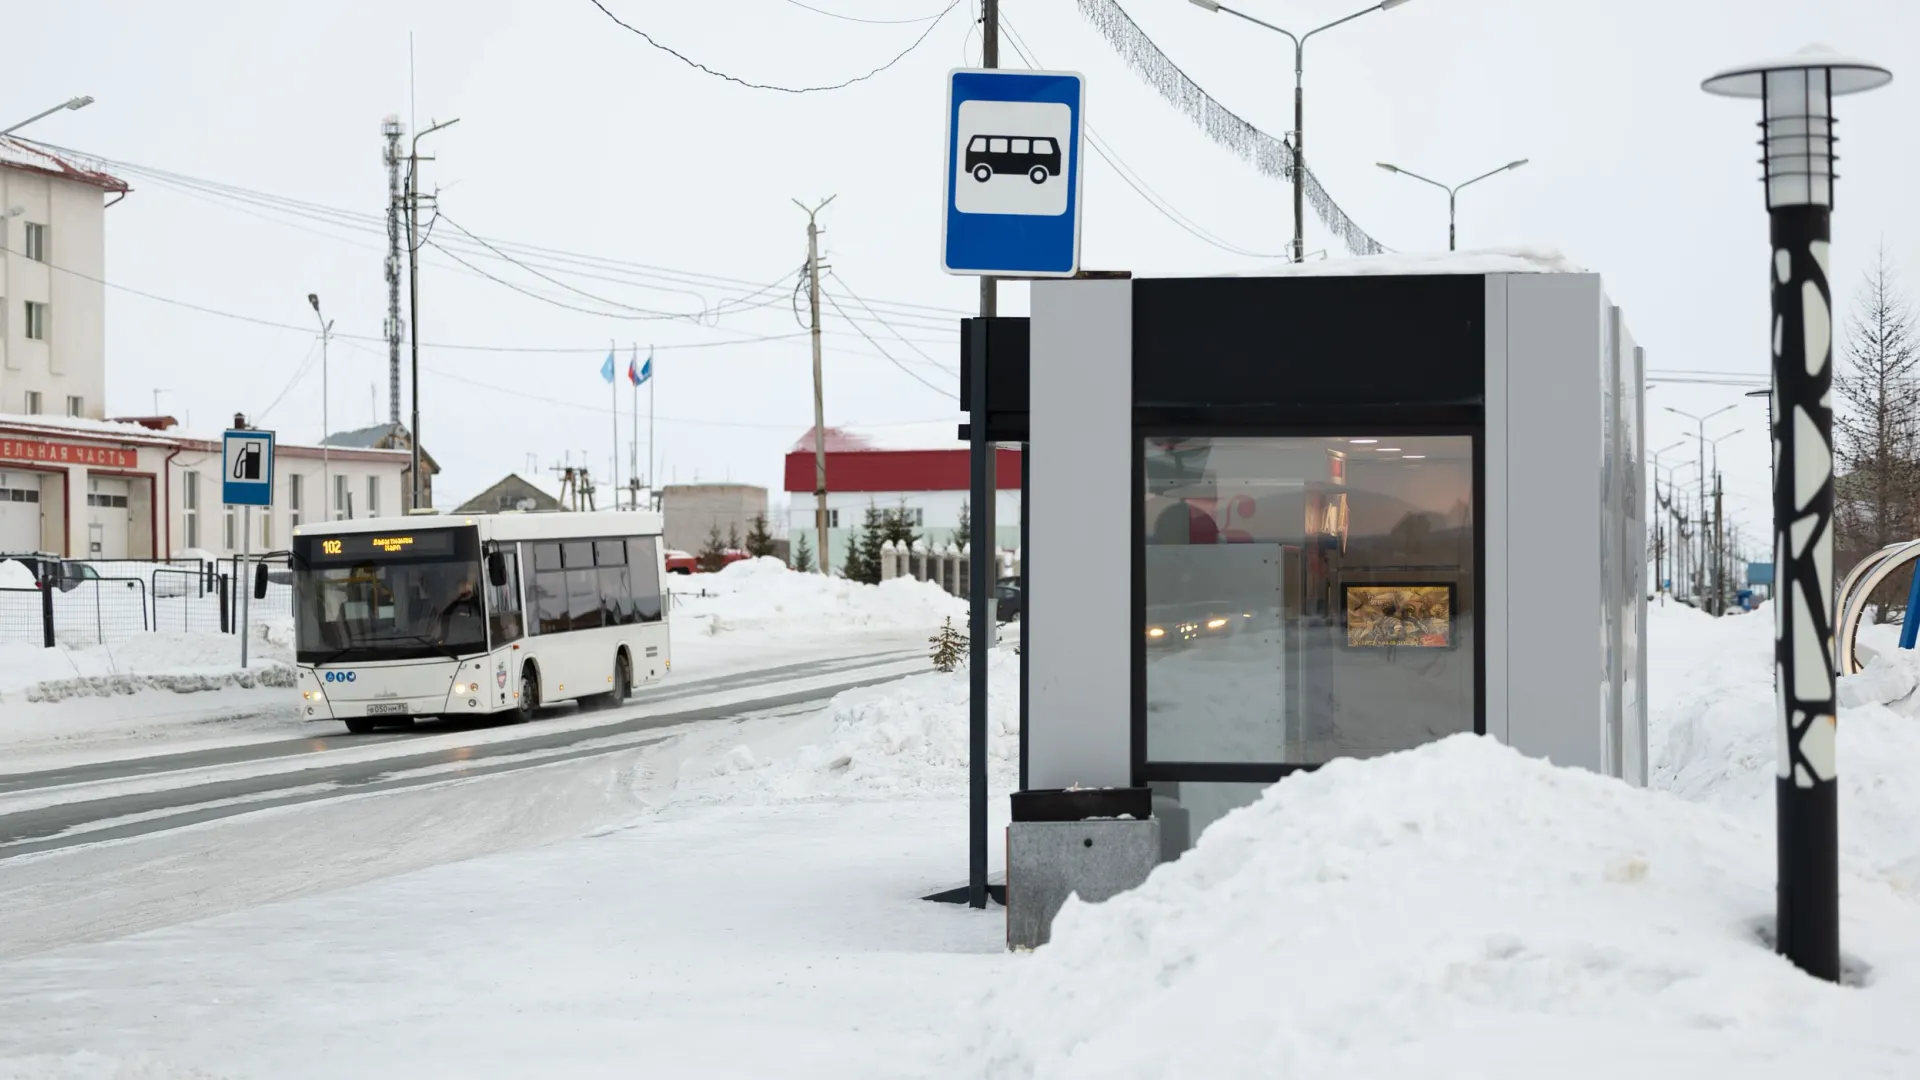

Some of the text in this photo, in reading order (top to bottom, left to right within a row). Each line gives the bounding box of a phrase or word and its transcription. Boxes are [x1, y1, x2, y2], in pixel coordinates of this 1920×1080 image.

[3, 442, 126, 465] ЕЛЬНАЯ ЧАСТЬ
[322, 540, 342, 554] 102
